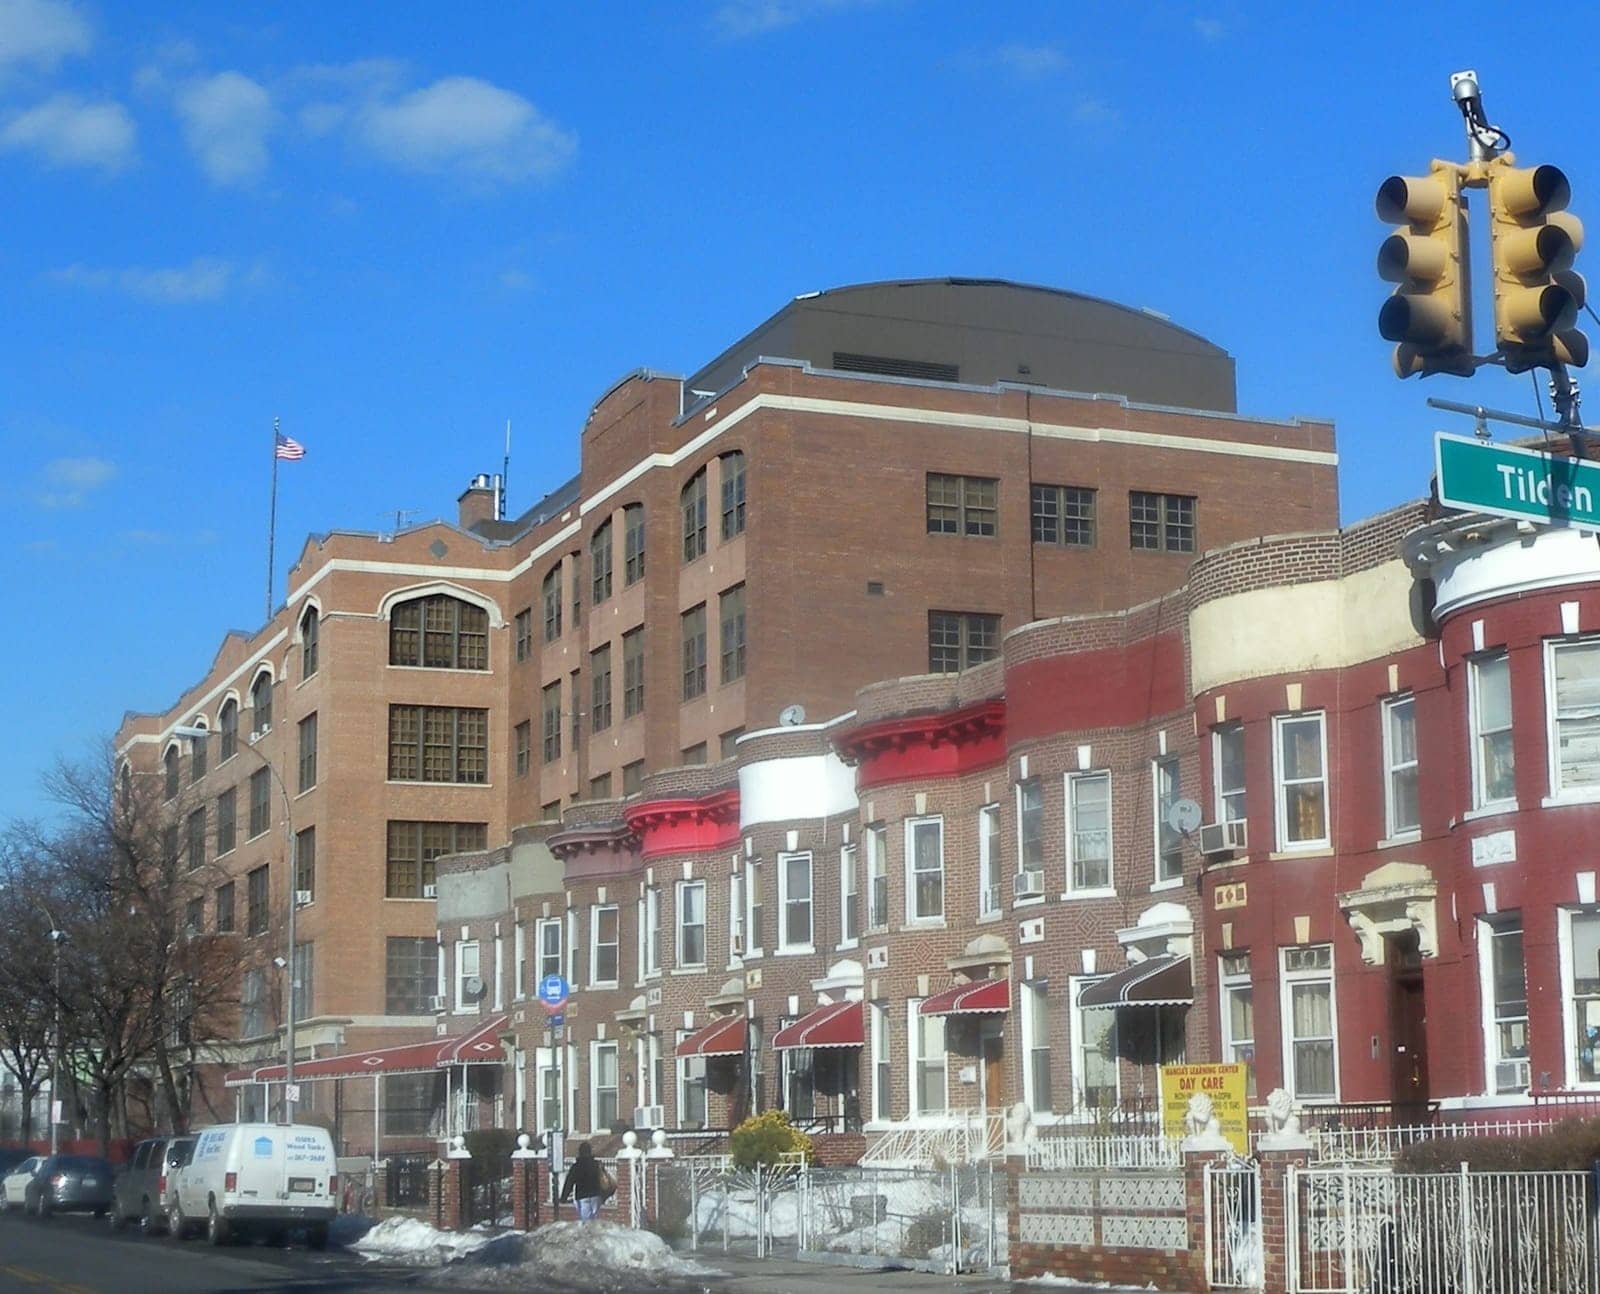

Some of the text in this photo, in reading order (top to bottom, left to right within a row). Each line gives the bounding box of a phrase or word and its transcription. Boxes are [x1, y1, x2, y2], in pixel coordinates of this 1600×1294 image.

[1497, 463, 1593, 513] Tilden
[1218, 1065, 1239, 1074] CENTER
[1179, 1076, 1224, 1090] DAY CARE
